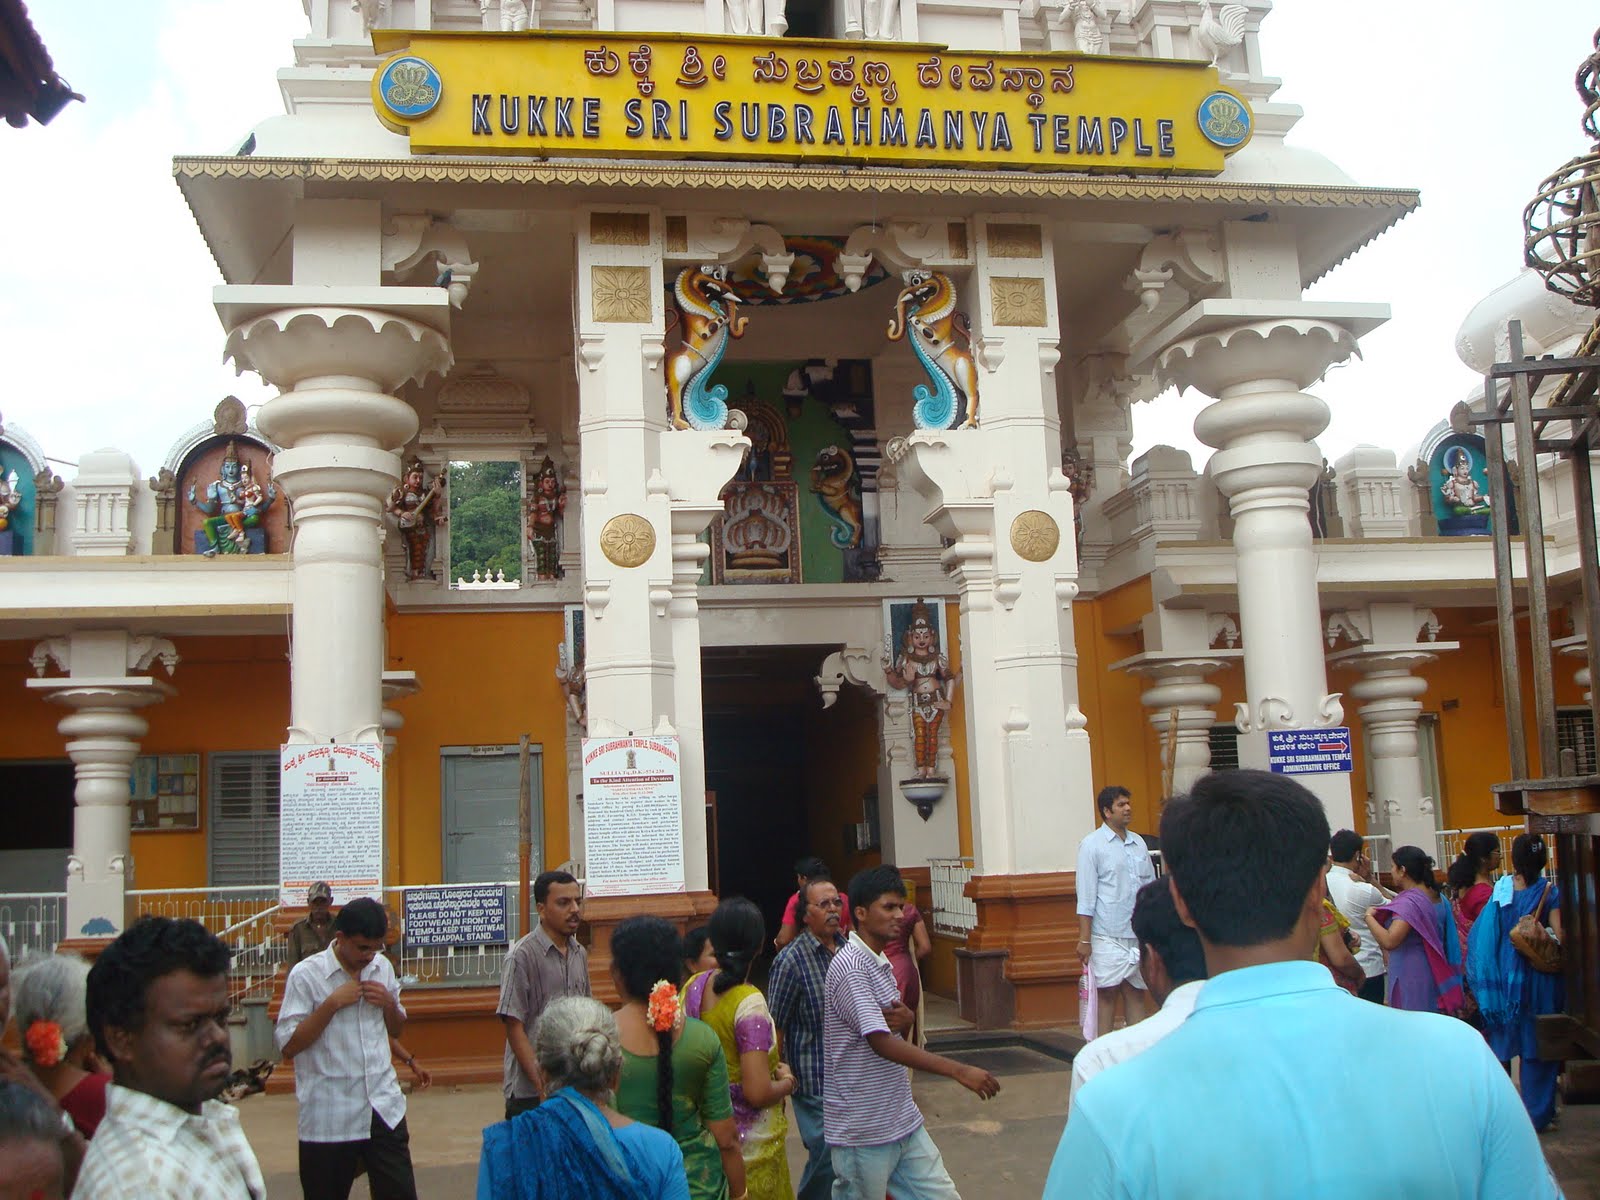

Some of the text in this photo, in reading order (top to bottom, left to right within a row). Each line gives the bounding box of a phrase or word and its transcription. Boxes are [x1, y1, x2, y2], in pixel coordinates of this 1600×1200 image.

[584, 44, 1075, 109] ಕುಕ್ಕೆ ಶ್ರೀ ಸುಬ್ರಹ್ಮಣ್ಯ ದೇವಸ್ಥಾನ
[472, 93, 1176, 157] KUKKE SRI SUBRAHMANYA TEMPLE
[585, 748, 598, 766] KUKKE
[1270, 752, 1351, 764] KUKKE SRI SUBRAHMANYA TEMPLE
[1282, 762, 1341, 773] ADMINISTRATIVE OFFICE
[409, 908, 502, 920] PLEASE DO NOT KEEP YOUR
[462, 916, 489, 925] FRONT
[473, 924, 504, 932] FOOTWEAR
[409, 936, 415, 944] IN
[432, 934, 465, 942] CHAPPAL
